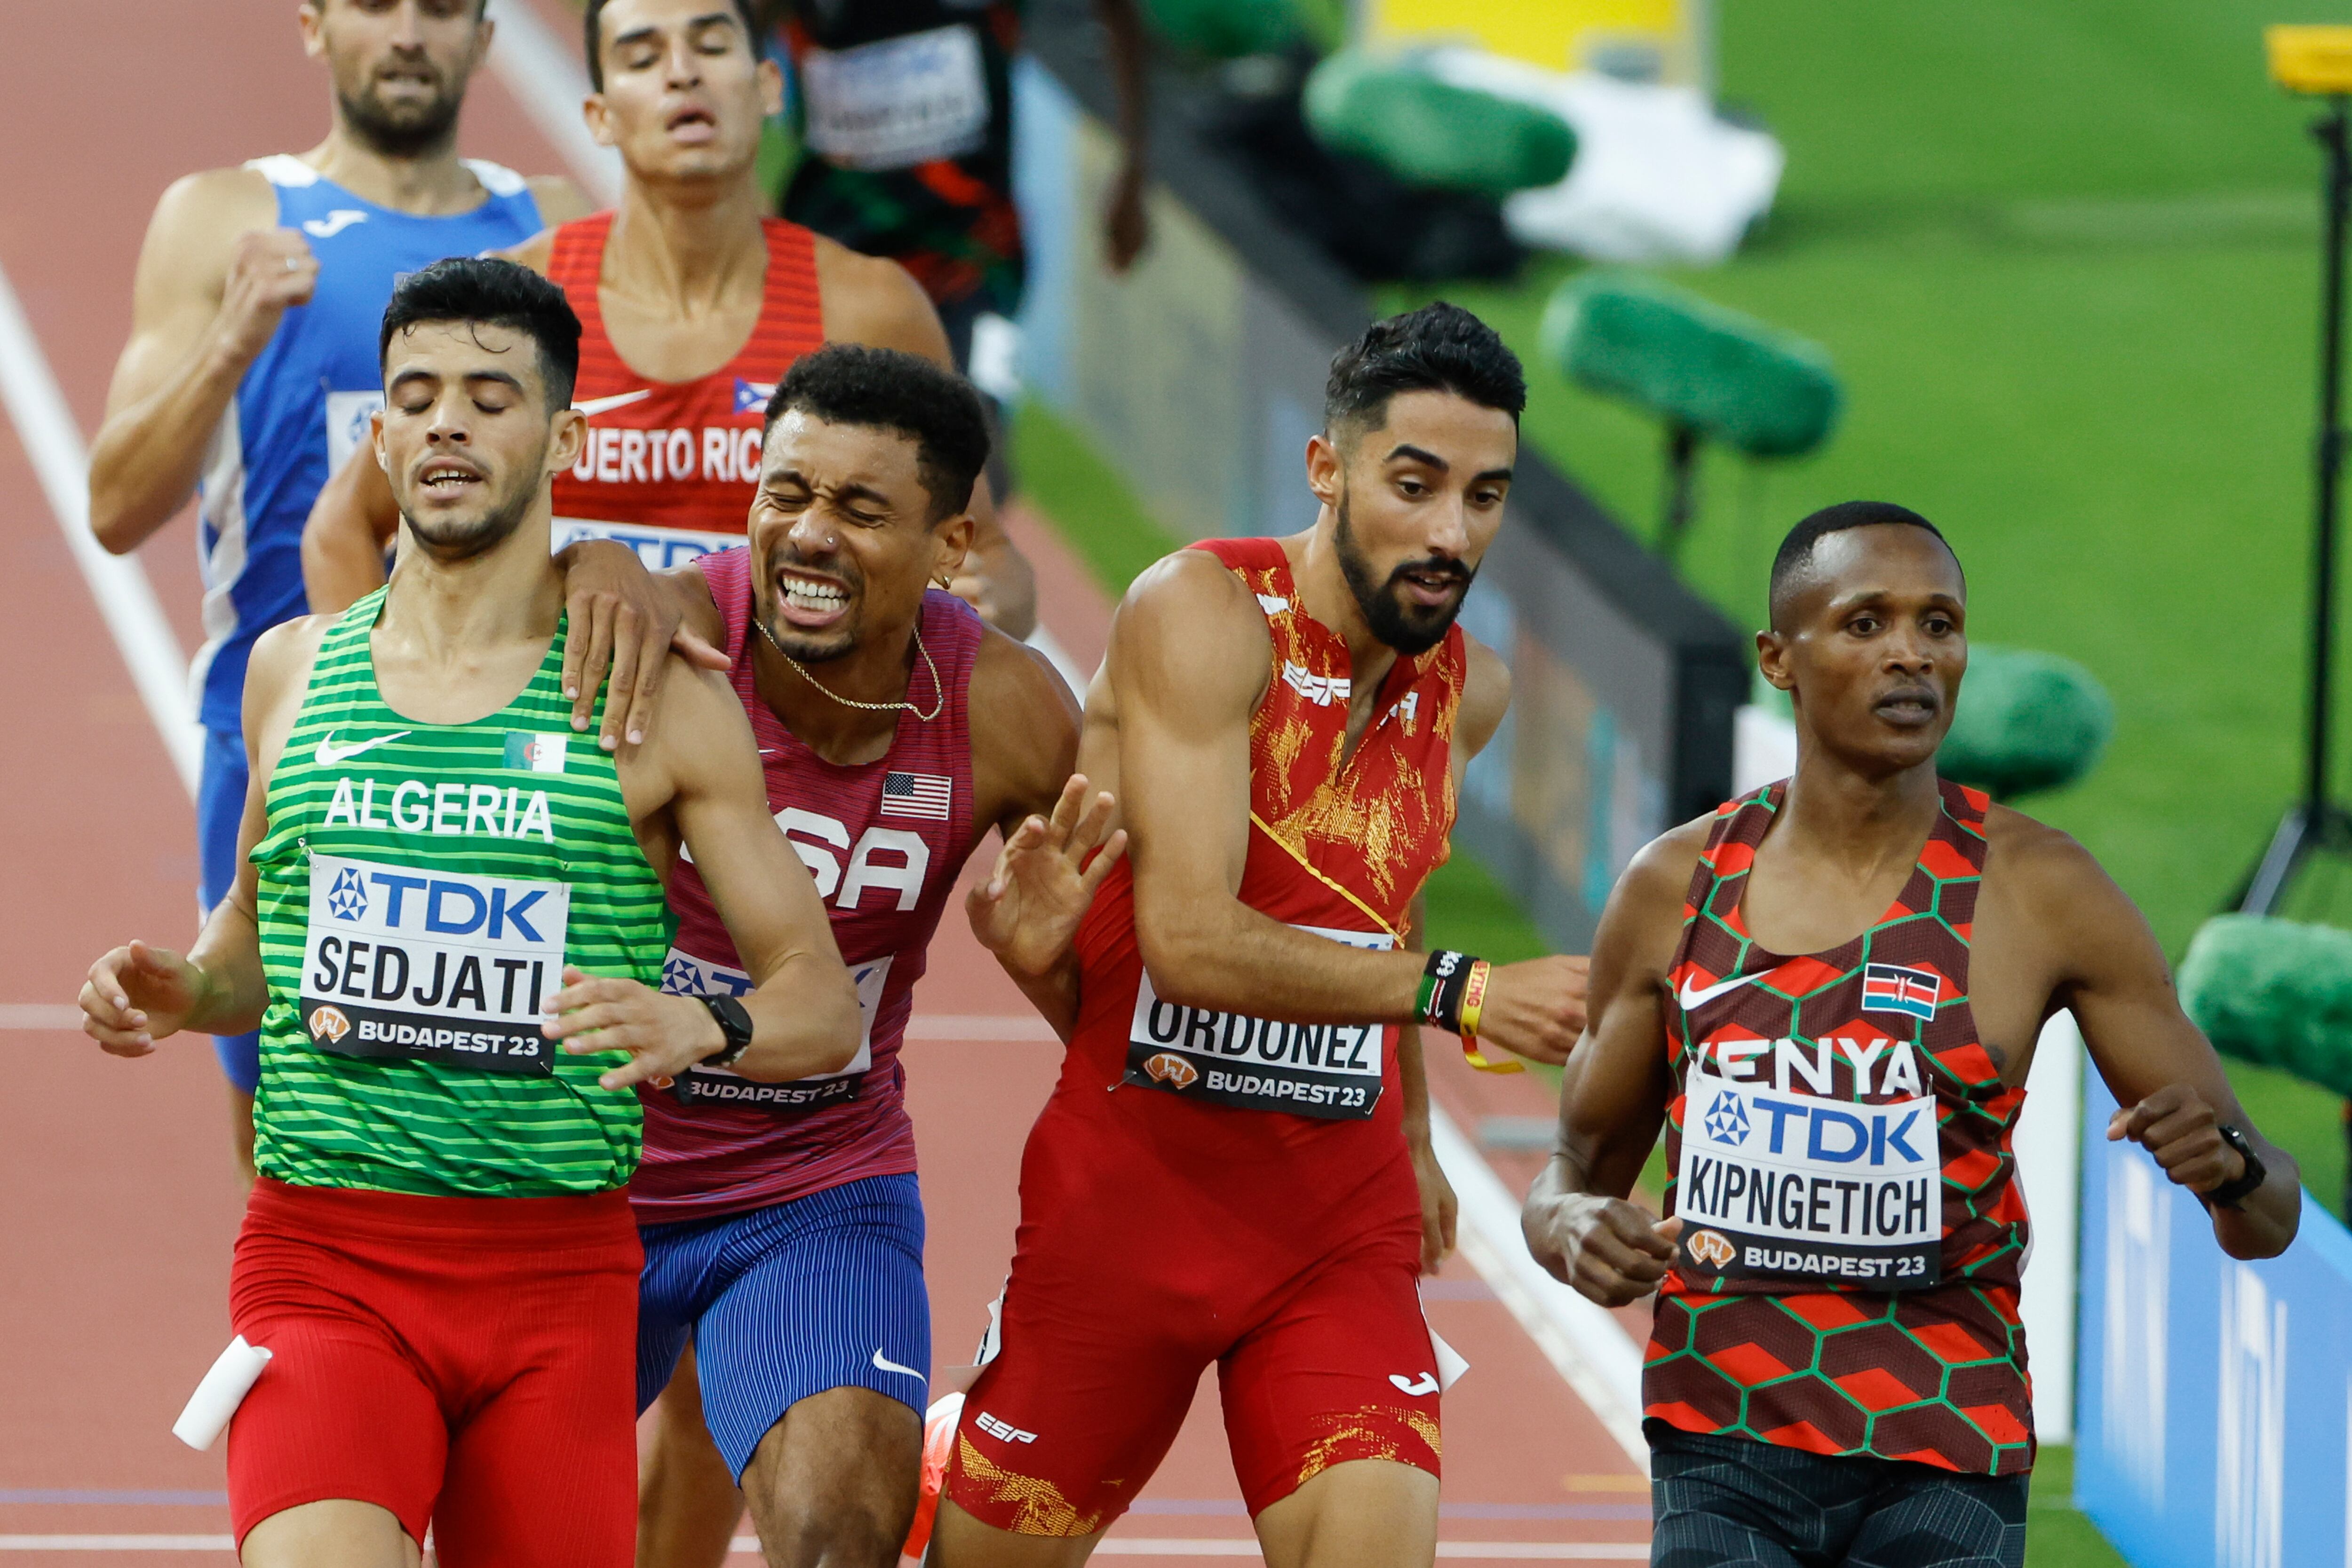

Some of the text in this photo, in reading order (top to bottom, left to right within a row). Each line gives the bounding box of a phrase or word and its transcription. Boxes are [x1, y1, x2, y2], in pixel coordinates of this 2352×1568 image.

[572, 427, 763, 483] UERTO RIC
[323, 777, 554, 843] ALGERIA
[679, 806, 930, 911] SA
[371, 871, 549, 942] TDK
[314, 936, 544, 1016] SEDJATI
[358, 1020, 539, 1056] BUDAPEST 23
[690, 1080, 849, 1103] BUDAPEST 23
[1206, 1070, 1366, 1107] BUDAPEST 23
[1752, 1097, 1924, 1166] TDK
[1687, 1154, 1928, 1237] KIPNGETICH
[1744, 1246, 1926, 1277] BUDAPEST 23
[975, 1411, 1039, 1444] ESP
